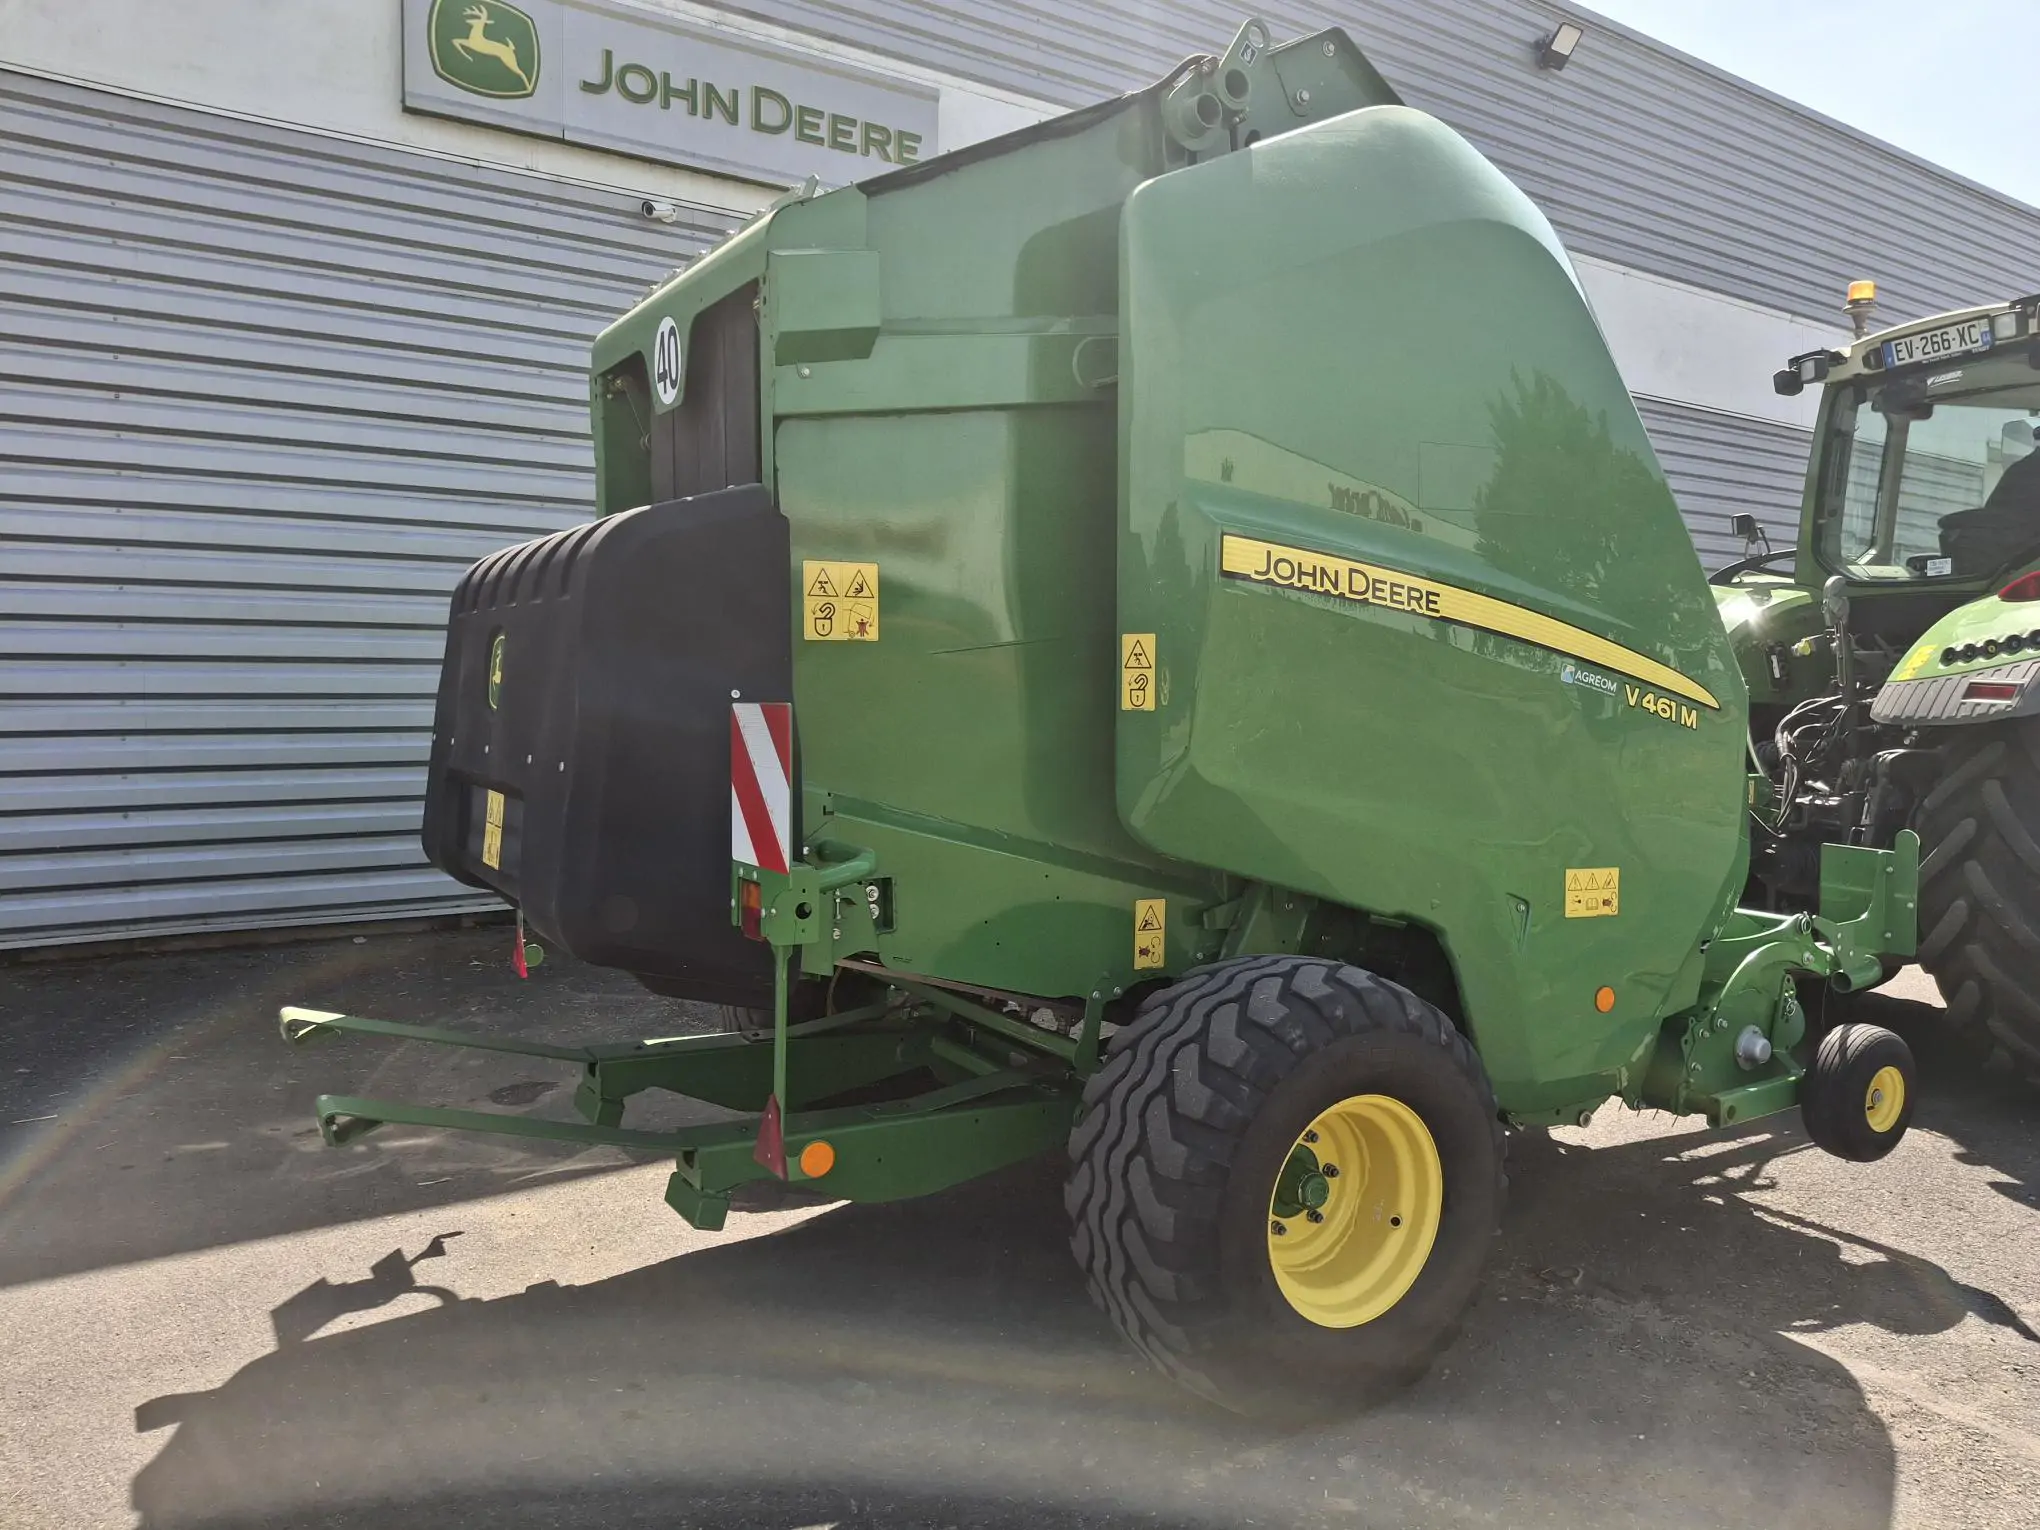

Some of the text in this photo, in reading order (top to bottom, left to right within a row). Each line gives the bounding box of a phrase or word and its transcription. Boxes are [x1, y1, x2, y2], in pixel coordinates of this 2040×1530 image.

[579, 48, 922, 166] JOHN DEERE
[657, 325, 680, 394] 40
[1894, 324, 1979, 362] EV-266-XC
[1253, 550, 1441, 614] JOHN DEERE
[1625, 683, 1640, 707] V
[1641, 692, 1677, 722] 461
[1680, 705, 1697, 730] M
